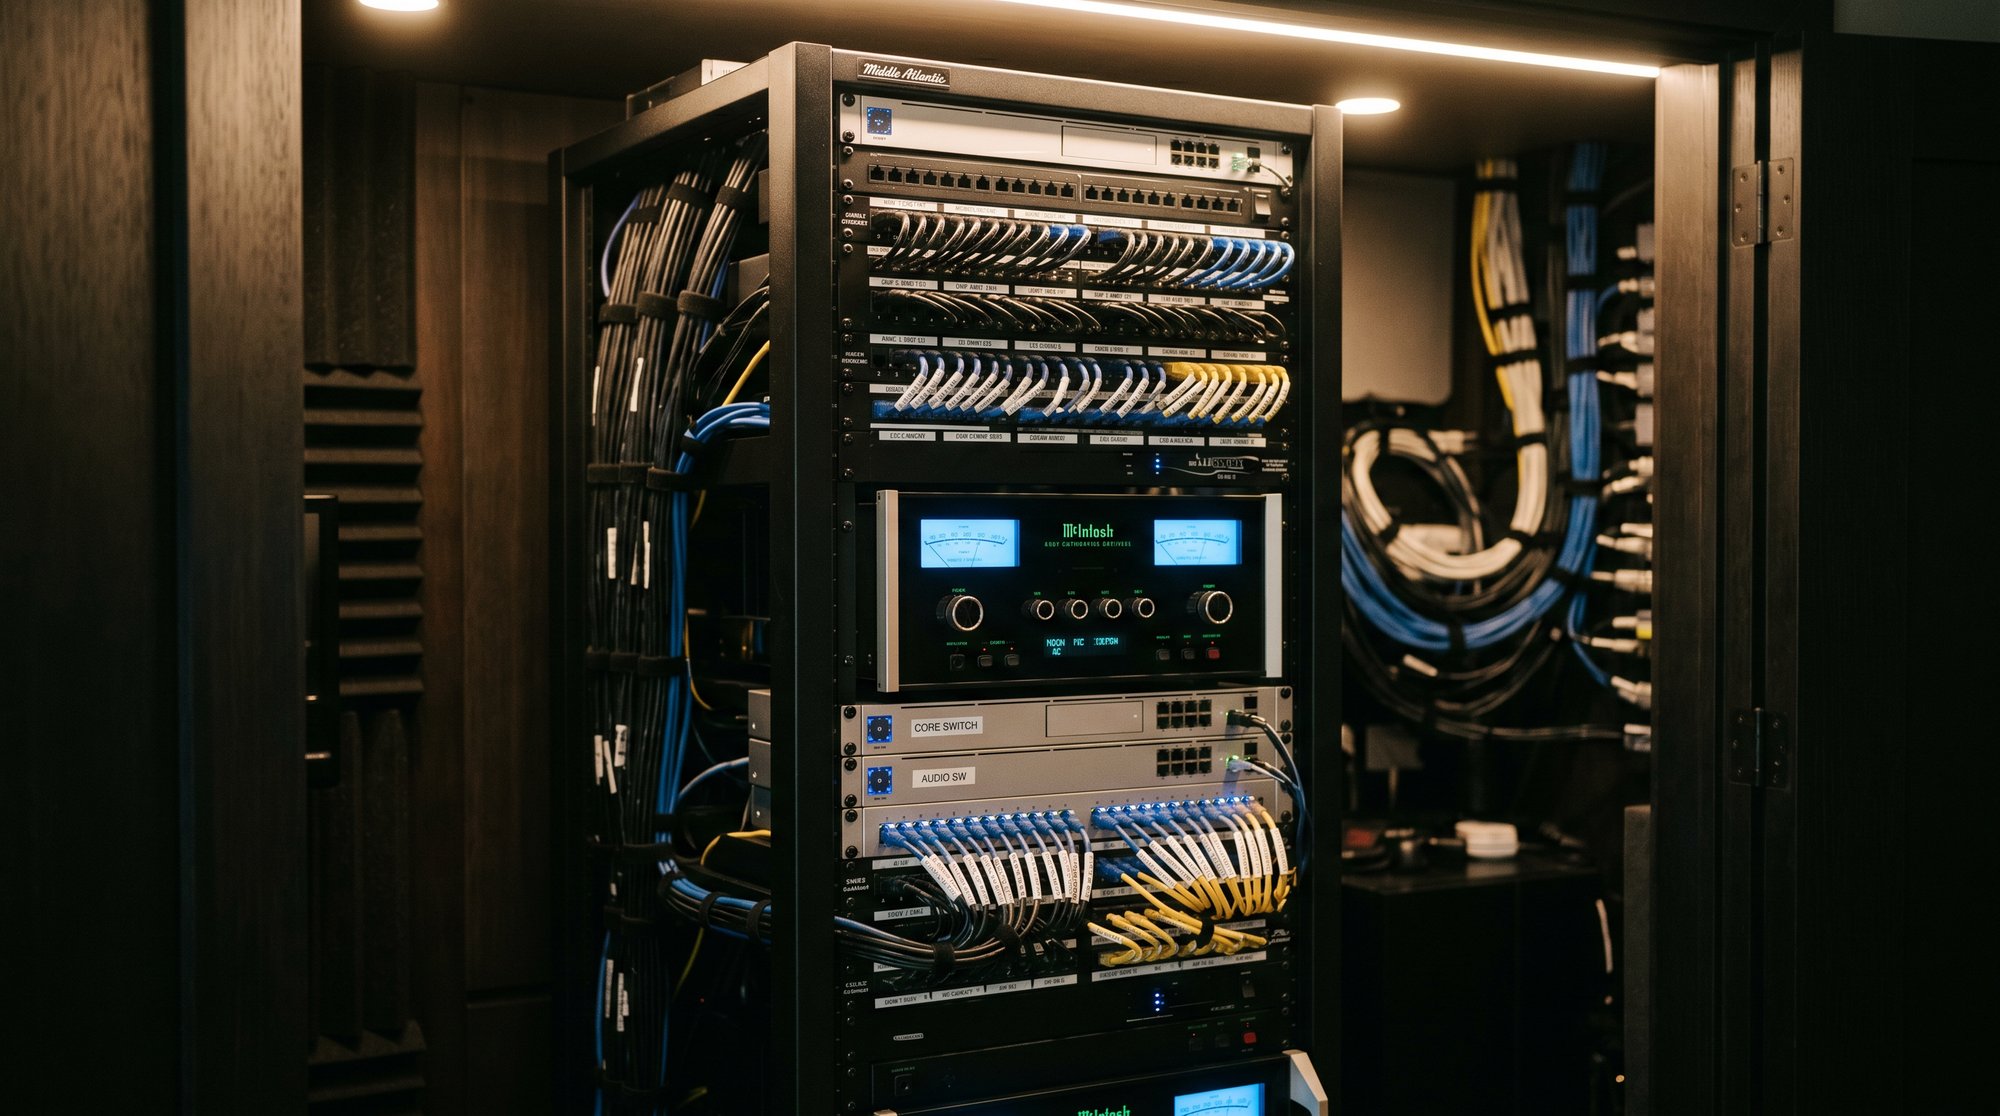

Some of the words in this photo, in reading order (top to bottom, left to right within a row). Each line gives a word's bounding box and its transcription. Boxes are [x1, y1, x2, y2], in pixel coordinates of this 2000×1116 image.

[863, 63, 901, 79] Middle
[901, 67, 946, 84] Atlantic
[1063, 523, 1114, 538] McIntosh
[914, 722, 941, 733] CORE
[942, 721, 978, 731] SWITCH
[921, 773, 950, 783] AUDIO
[951, 772, 967, 781] SW
